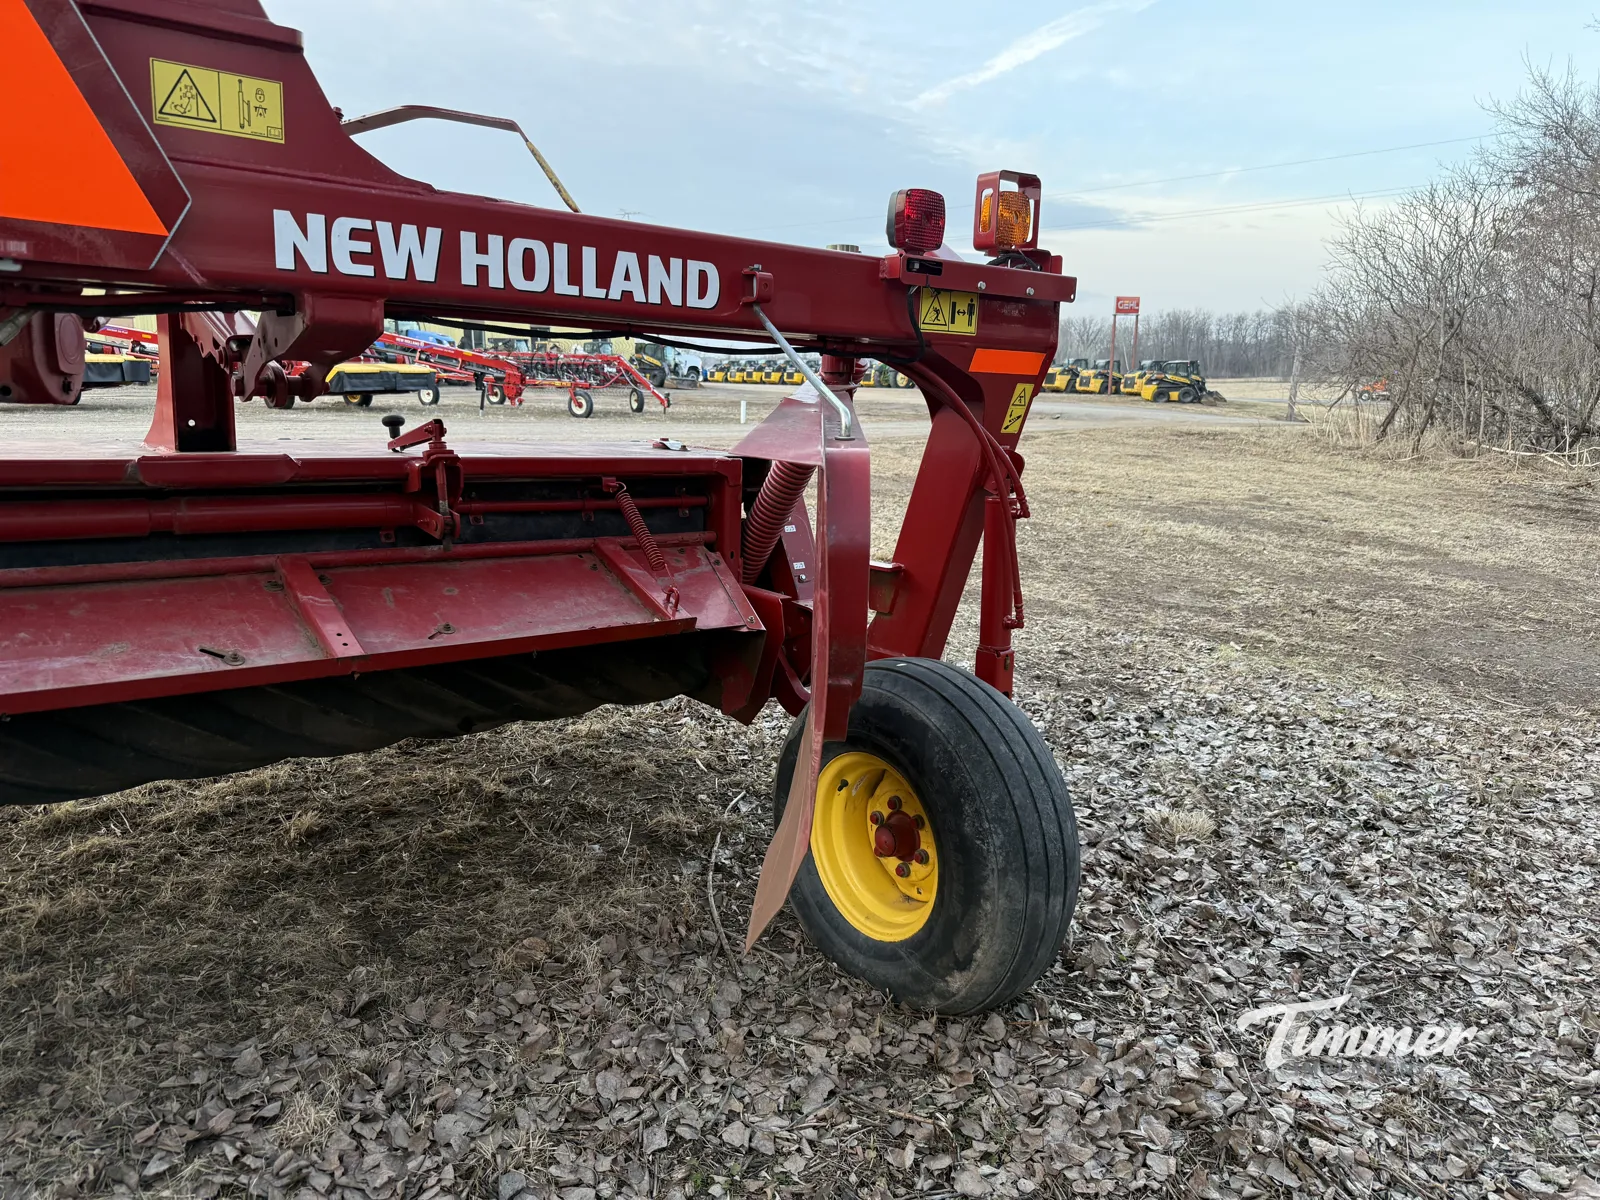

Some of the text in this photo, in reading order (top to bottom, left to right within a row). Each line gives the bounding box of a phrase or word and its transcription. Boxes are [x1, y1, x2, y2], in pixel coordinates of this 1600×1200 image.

[273, 209, 721, 310] NEW HOLLAND
[1117, 300, 1139, 310] GEHL
